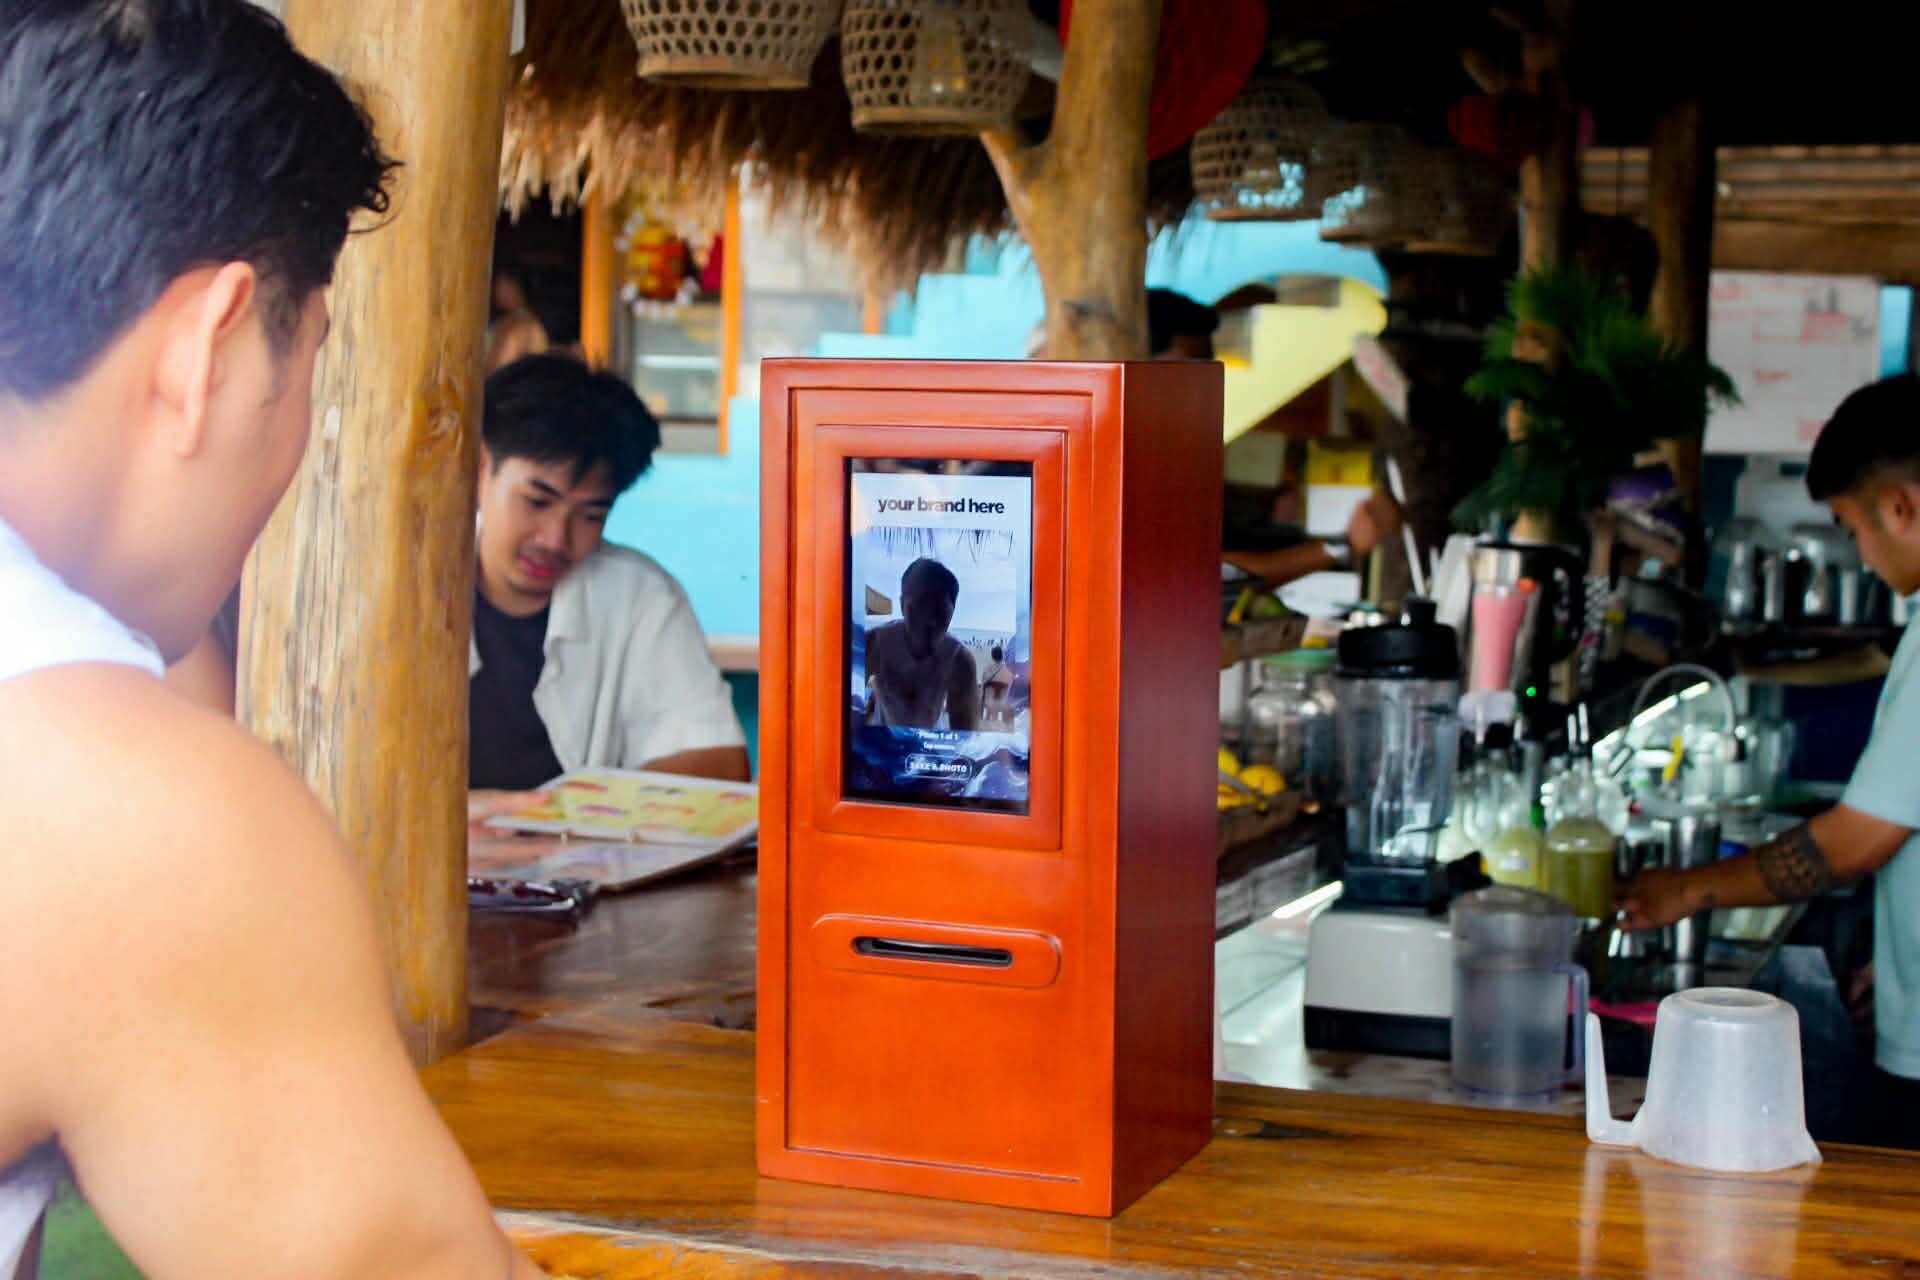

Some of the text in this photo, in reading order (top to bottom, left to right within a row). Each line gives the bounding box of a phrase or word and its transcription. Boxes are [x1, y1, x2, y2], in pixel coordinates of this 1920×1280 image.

[878, 496, 1005, 514] your brand here
[939, 763, 967, 773] PHOTO
